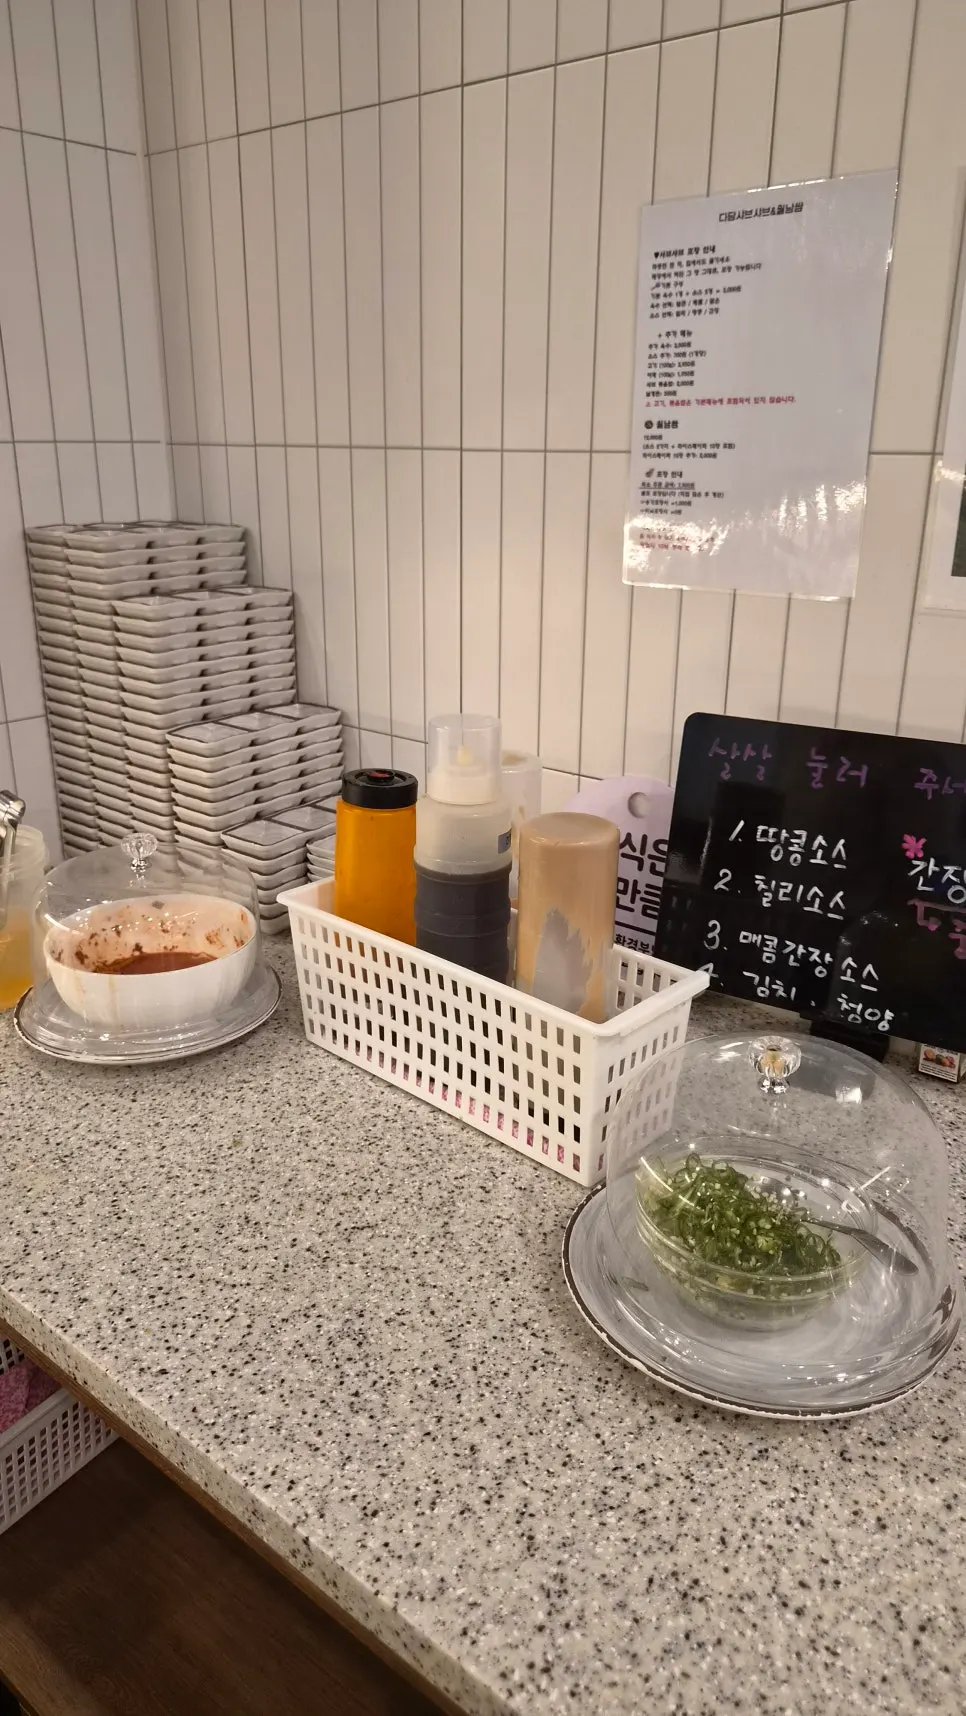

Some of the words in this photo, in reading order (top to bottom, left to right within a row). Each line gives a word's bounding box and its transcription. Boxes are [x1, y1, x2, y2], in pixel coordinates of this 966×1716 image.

[709, 738, 772, 781] 살살
[806, 748, 869, 789] 눌러
[756, 824, 847, 870] 땅콩소스
[755, 874, 846, 920] 칠리소스
[837, 993, 895, 1032] 청양
